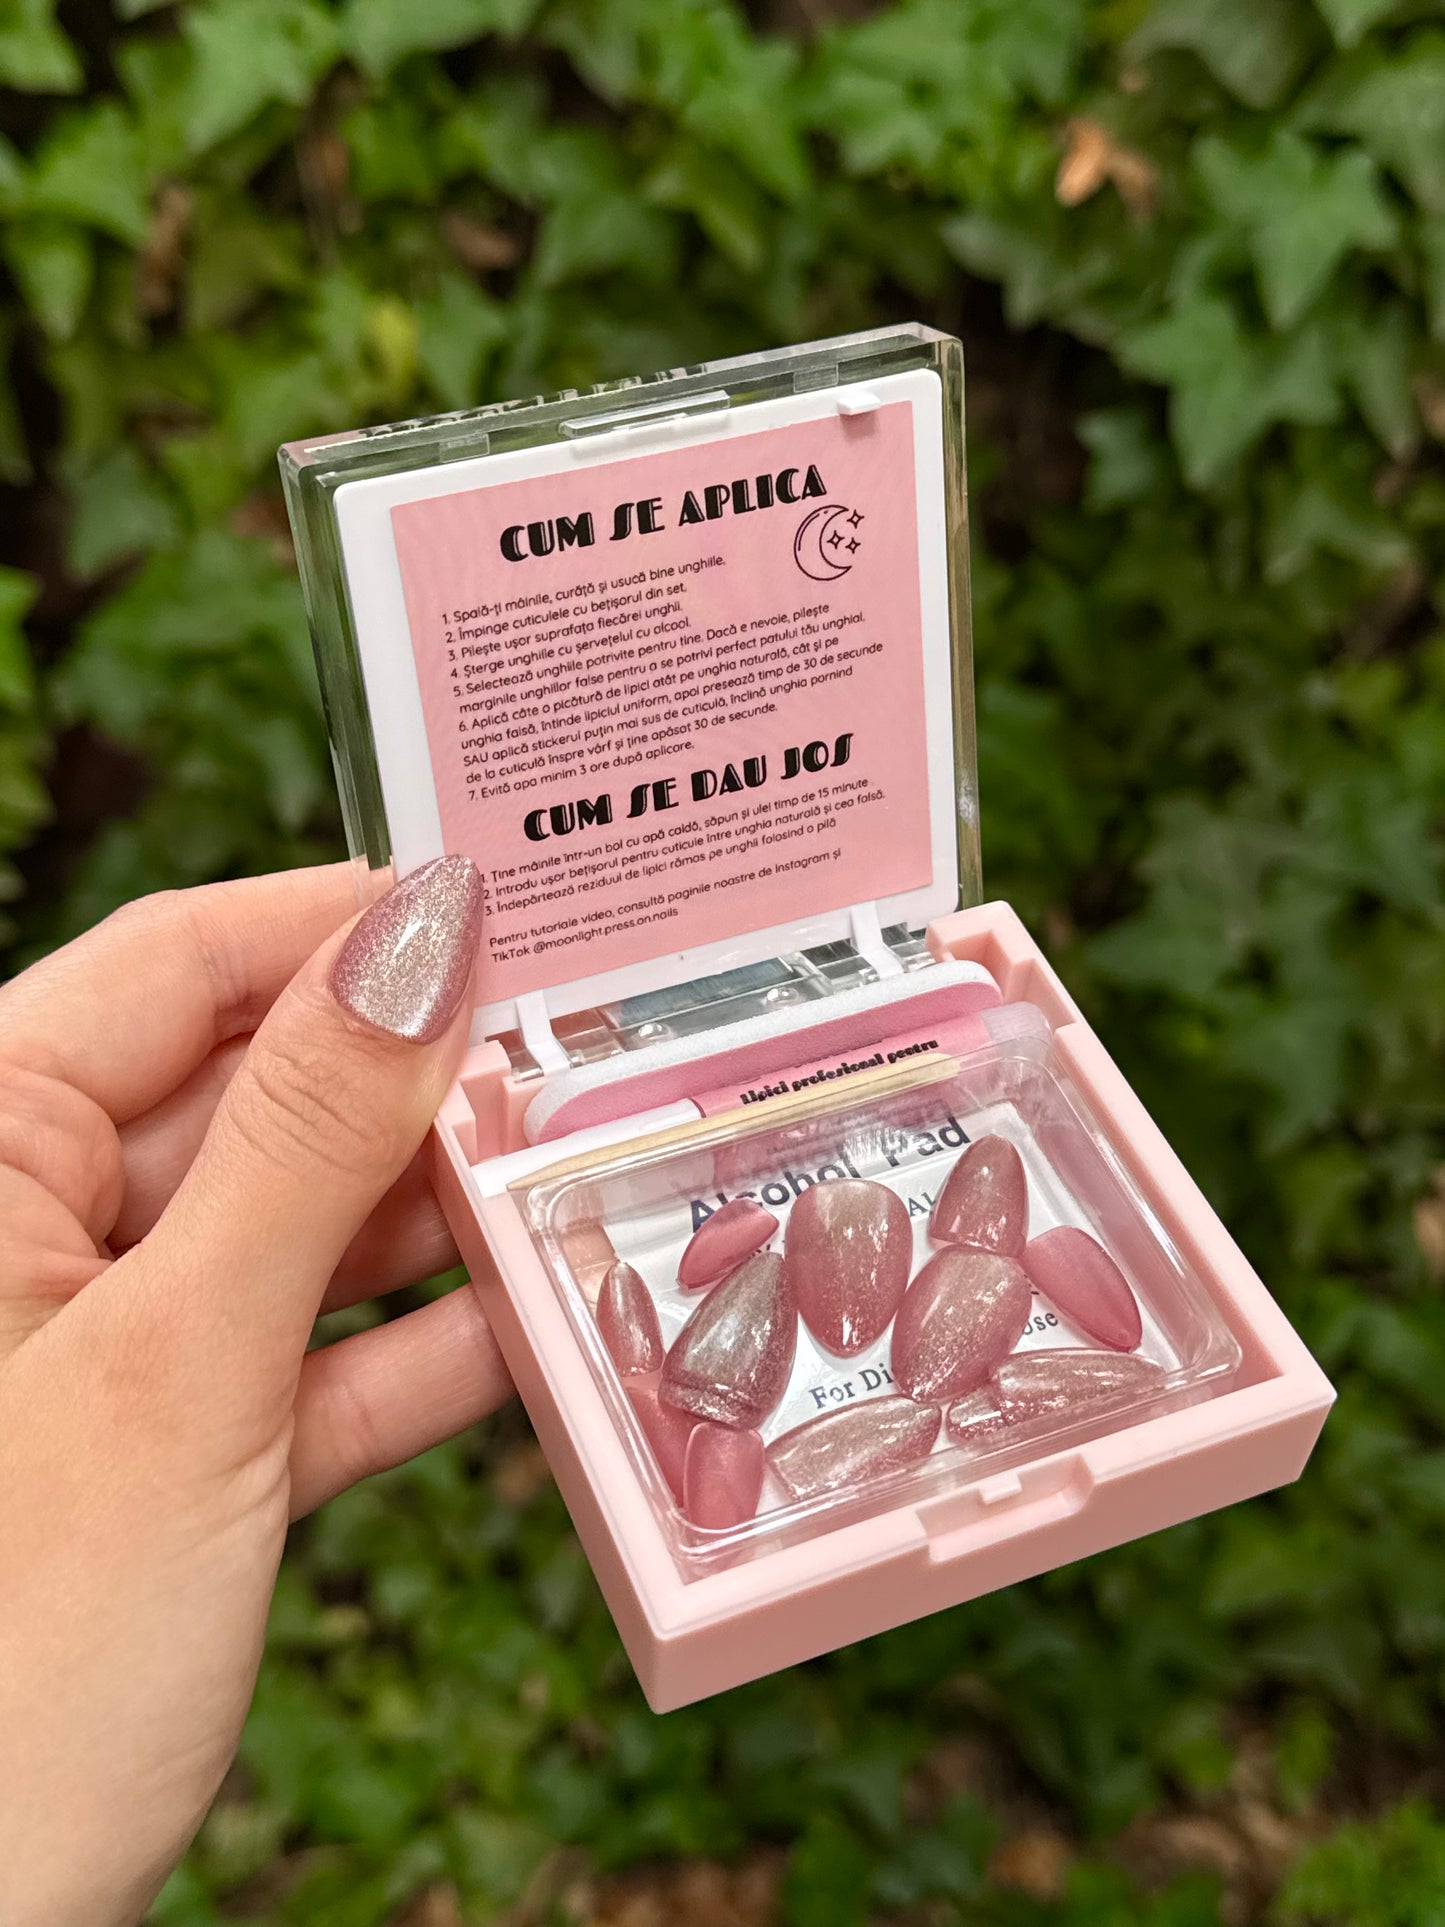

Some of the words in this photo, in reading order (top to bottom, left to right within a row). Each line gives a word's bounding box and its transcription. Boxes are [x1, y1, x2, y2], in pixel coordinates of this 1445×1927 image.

[499, 511, 595, 562] CUM
[608, 496, 665, 541] SE
[677, 464, 827, 526] APLICA
[457, 621, 510, 641] Împinge
[512, 607, 570, 630] cuticulele
[572, 605, 588, 617] cu
[644, 587, 664, 601] din
[665, 582, 688, 596] set.
[596, 609, 643, 630] fiecărei
[644, 600, 684, 619] unghii.
[610, 570, 647, 590] usucă
[648, 566, 676, 582] bine
[677, 554, 727, 575] unghiile.
[459, 692, 518, 715] marginile
[519, 680, 572, 701] unghiilor
[574, 673, 605, 689] false
[606, 664, 647, 684] pentru
[648, 661, 658, 672] a
[660, 657, 674, 670] se
[676, 646, 713, 669] potrivi
[715, 637, 757, 659] perfect
[759, 627, 799, 649] patului
[800, 623, 820, 636] tău
[822, 610, 866, 631] unghial.
[465, 669, 534, 695] Selectează
[535, 659, 584, 680] unghiile
[585, 649, 635, 671] potrivite
[637, 639, 677, 659] pentru
[679, 633, 705, 648] tine.
[705, 623, 738, 642] Dacă
[739, 623, 748, 633] e
[749, 613, 791, 631] nevoie,
[471, 711, 510, 731] Aplică
[511, 706, 540, 721] câte
[552, 690, 604, 715] picătură
[605, 686, 622, 700] de
[623, 679, 651, 696] lipici
[652, 673, 677, 689] atât
[679, 670, 695, 685] pe
[697, 660, 737, 679] unghia
[792, 642, 811, 656] cât
[824, 636, 840, 651] pe
[507, 647, 556, 668] unghiile
[557, 645, 573, 657] cu
[635, 627, 651, 640] cu
[653, 615, 692, 636] alcool.
[460, 732, 504, 751] unghia
[540, 713, 582, 732] întinde
[584, 702, 621, 724] lipiciul
[623, 694, 673, 713] uniform,
[673, 684, 700, 702] apoi
[702, 671, 756, 697] presează
[757, 667, 784, 681] timp
[785, 662, 801, 675] de
[803, 656, 818, 671] 30
[819, 653, 835, 667] de
[836, 641, 884, 663] secunde
[462, 751, 489, 768] SAU
[491, 742, 530, 762] aplică
[531, 729, 582, 752] stickerul
[616, 716, 639, 732] mai
[641, 713, 662, 727] sus
[663, 708, 679, 721] de
[729, 686, 767, 705] înclină
[769, 678, 808, 696] unghia
[810, 664, 854, 688] pornind
[465, 771, 482, 785] de
[484, 768, 497, 780] la
[498, 755, 546, 777] cuticulă
[547, 749, 585, 765] înspre
[586, 739, 612, 756] vârf
[650, 722, 692, 742] apăsat
[693, 717, 709, 731] 30
[710, 714, 727, 727] de
[728, 702, 778, 723] secunde.
[480, 781, 512, 799] Evită
[512, 777, 538, 792] apa
[539, 768, 578, 785] minim
[578, 763, 588, 776] 3
[589, 760, 610, 774] ore
[612, 750, 644, 768] după
[645, 740, 695, 761] aplicare.
[523, 793, 613, 841] CUM
[626, 777, 679, 818] SE
[690, 754, 767, 801] DAU
[780, 732, 853, 780] JOS
[484, 905, 495, 917] 3.
[495, 884, 575, 913] Îndepărtează
[577, 871, 623, 894] reziduul
[624, 868, 641, 881] de
[642, 861, 668, 878] lipici
[669, 852, 707, 870] rămas
[708, 848, 724, 862] pe
[725, 837, 759, 855] unghii
[761, 824, 805, 846] folosind
[816, 817, 837, 834] pilă
[495, 877, 538, 897] Introdu
[620, 849, 659, 868] pentru
[661, 837, 705, 856] cuticule
[705, 829, 733, 844] între
[734, 819, 773, 837] unghia
[774, 805, 822, 827] naturală
[834, 798, 855, 812] cea
[518, 855, 562, 875] mâinile
[562, 846, 603, 864] într-un
[604, 838, 624, 854] bol
[625, 836, 641, 849] cu
[642, 827, 666, 845] apă
[703, 811, 739, 829] săpun
[752, 801, 772, 817] ulei
[773, 796, 800, 811] timp
[800, 792, 816, 804] de
[817, 786, 830, 799] 15
[831, 778, 869, 796] minute
[489, 931, 528, 948] Pentru
[529, 917, 579, 938] tutoriale
[580, 909, 616, 924] video,
[616, 893, 666, 916] consultă
[667, 882, 712, 905] paginile
[713, 871, 757, 890] noastre
[757, 866, 773, 879] de
[774, 852, 831, 874] Instagram
[490, 944, 531, 963] TikTok
[532, 907, 679, 955] @moonlight.press.on.nails
[740, 1080, 789, 1105] Lipici
[791, 1053, 885, 1091] profesional
[887, 1039, 940, 1064] pentru
[808, 1381, 856, 1409] For
